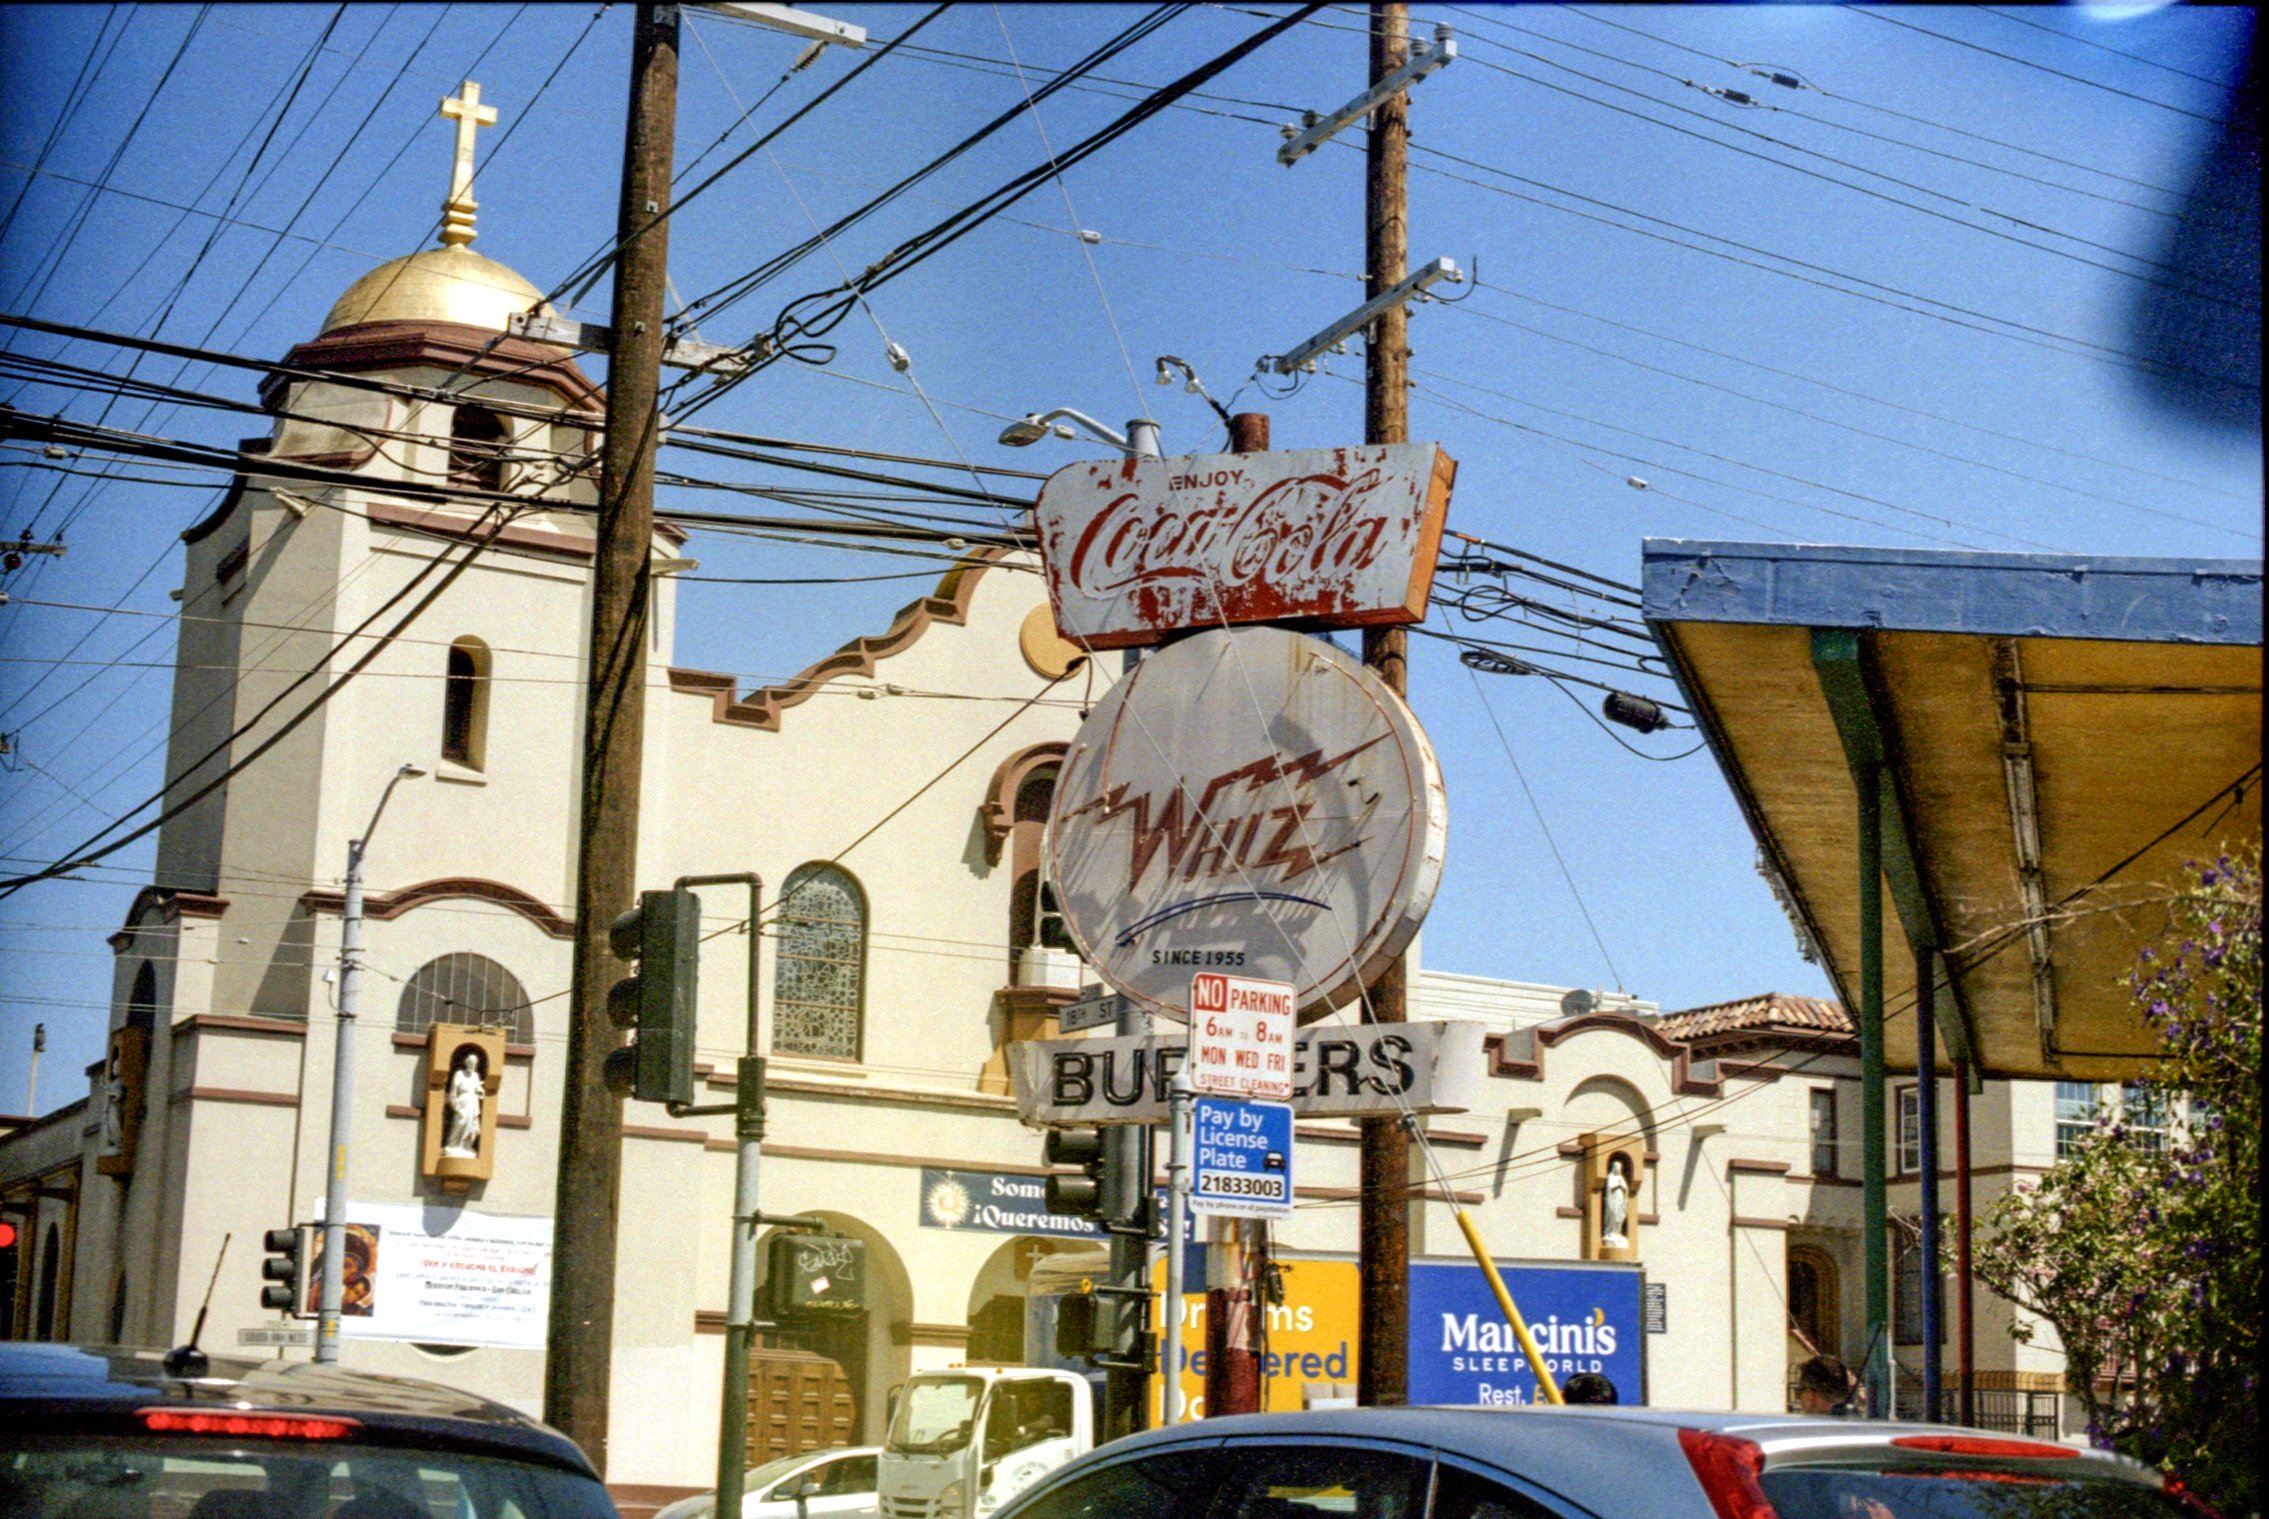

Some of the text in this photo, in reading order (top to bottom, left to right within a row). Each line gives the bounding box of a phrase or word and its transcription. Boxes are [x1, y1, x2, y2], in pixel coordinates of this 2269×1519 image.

[1169, 469, 1244, 491] ENJOY
[1060, 732, 1393, 893] WHIZ
[1152, 950, 1245, 966] SINCE 1955
[1199, 978, 1292, 1016] NO PARKING
[1099, 1001, 1113, 1019] ST
[1053, 1034, 1414, 1107] BURERS
[1201, 1046, 1285, 1072] MON WED FRI
[1201, 1073, 1235, 1088] STREET
[1201, 1105, 1263, 1132] Pay by
[1200, 1126, 1268, 1149] License
[1200, 1147, 1247, 1169] Plate
[991, 1177, 1046, 1198] Som
[1202, 1174, 1283, 1198] 21833003
[973, 1204, 1094, 1232] ¡Queremos
[1161, 1291, 1314, 1332] Drms
[1161, 1338, 1347, 1378] Deered
[1453, 1356, 1602, 1373] SLEEPORLD
